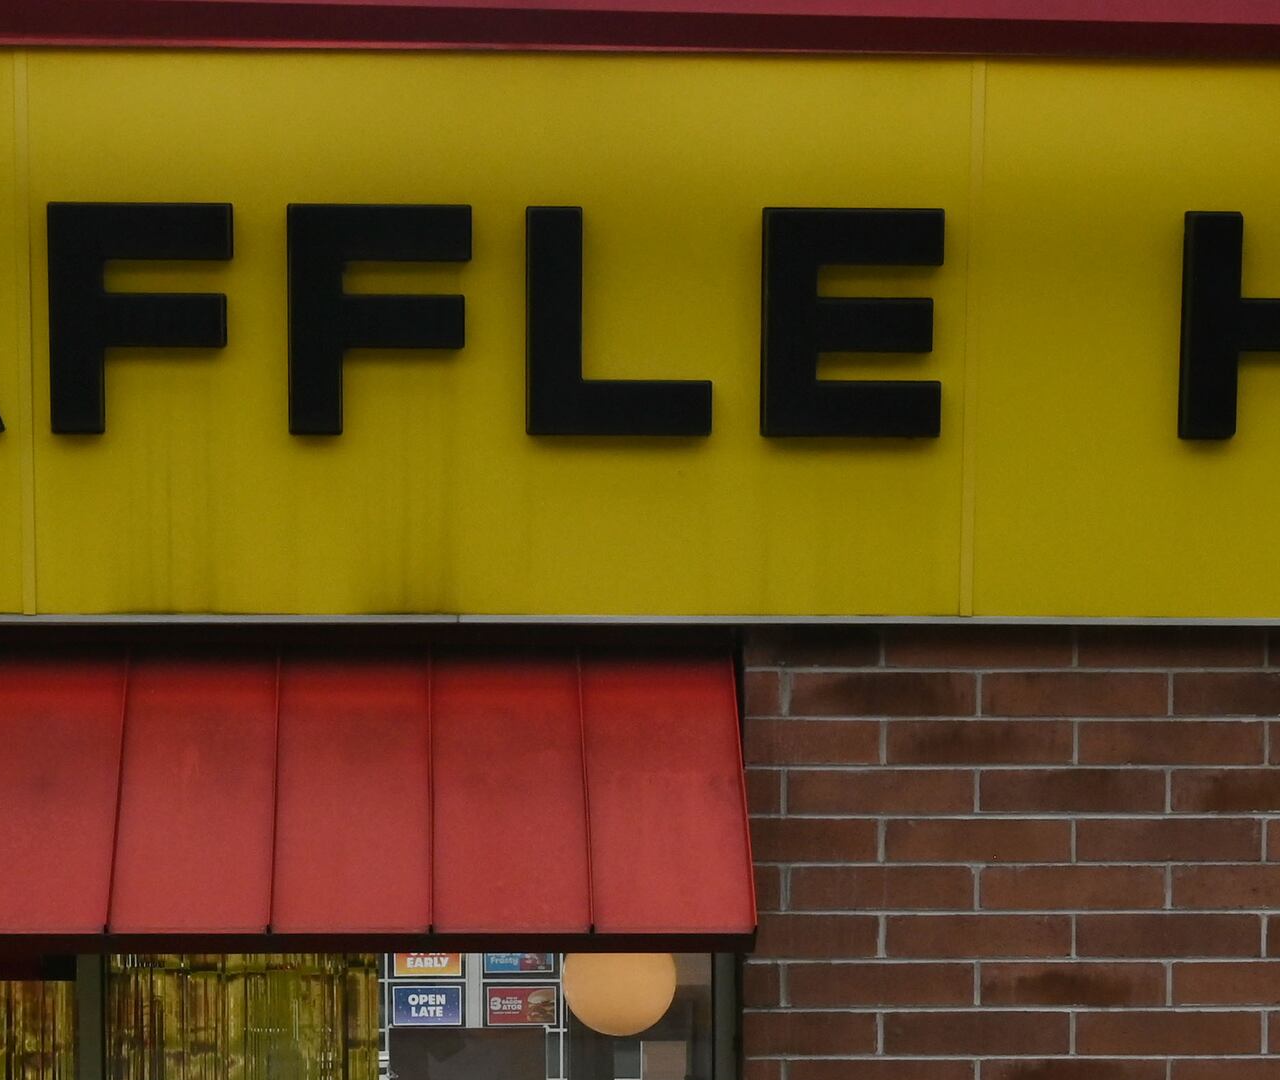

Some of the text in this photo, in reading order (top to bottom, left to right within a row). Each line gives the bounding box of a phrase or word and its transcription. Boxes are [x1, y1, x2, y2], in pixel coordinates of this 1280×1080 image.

[406, 957, 449, 968] EARLY
[489, 956, 520, 966] Frosty
[407, 994, 446, 1005] OPEN
[490, 996, 502, 1011] 3
[411, 1006, 443, 1017] LATE
